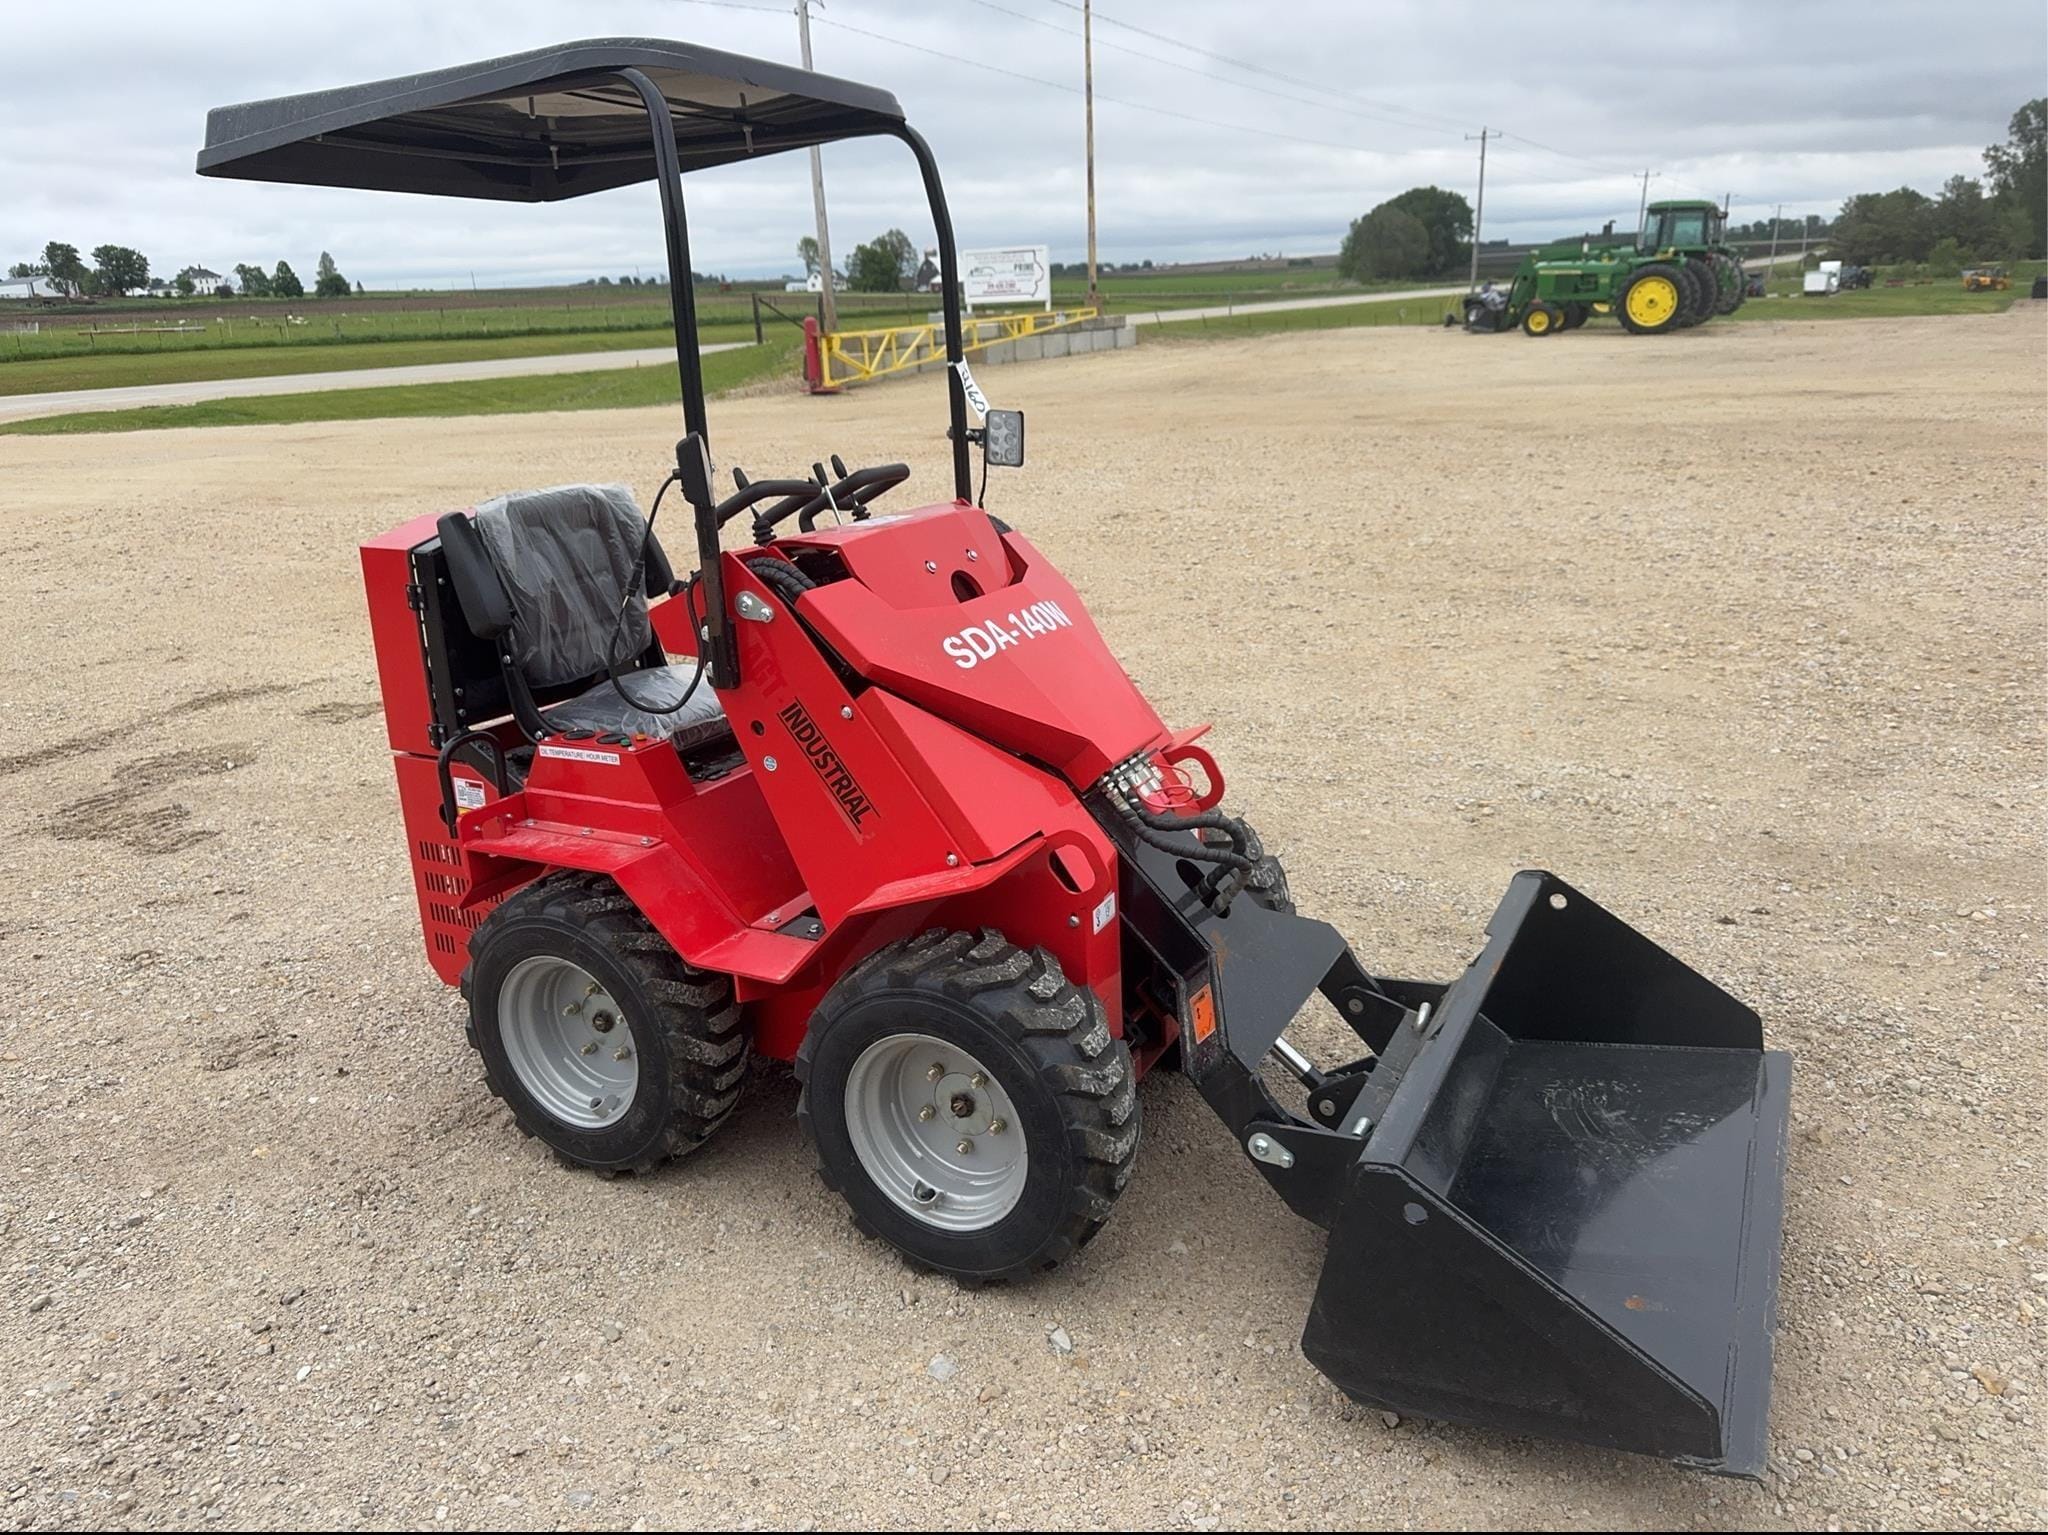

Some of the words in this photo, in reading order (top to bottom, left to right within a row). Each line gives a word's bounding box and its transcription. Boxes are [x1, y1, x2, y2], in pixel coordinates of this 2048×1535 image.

[943, 600, 1073, 669] SDA-140W
[549, 748, 584, 760] TEMPERATURE
[586, 752, 600, 760] HOUR
[601, 755, 618, 763] METER
[780, 701, 872, 825] INDUSTRIAL
